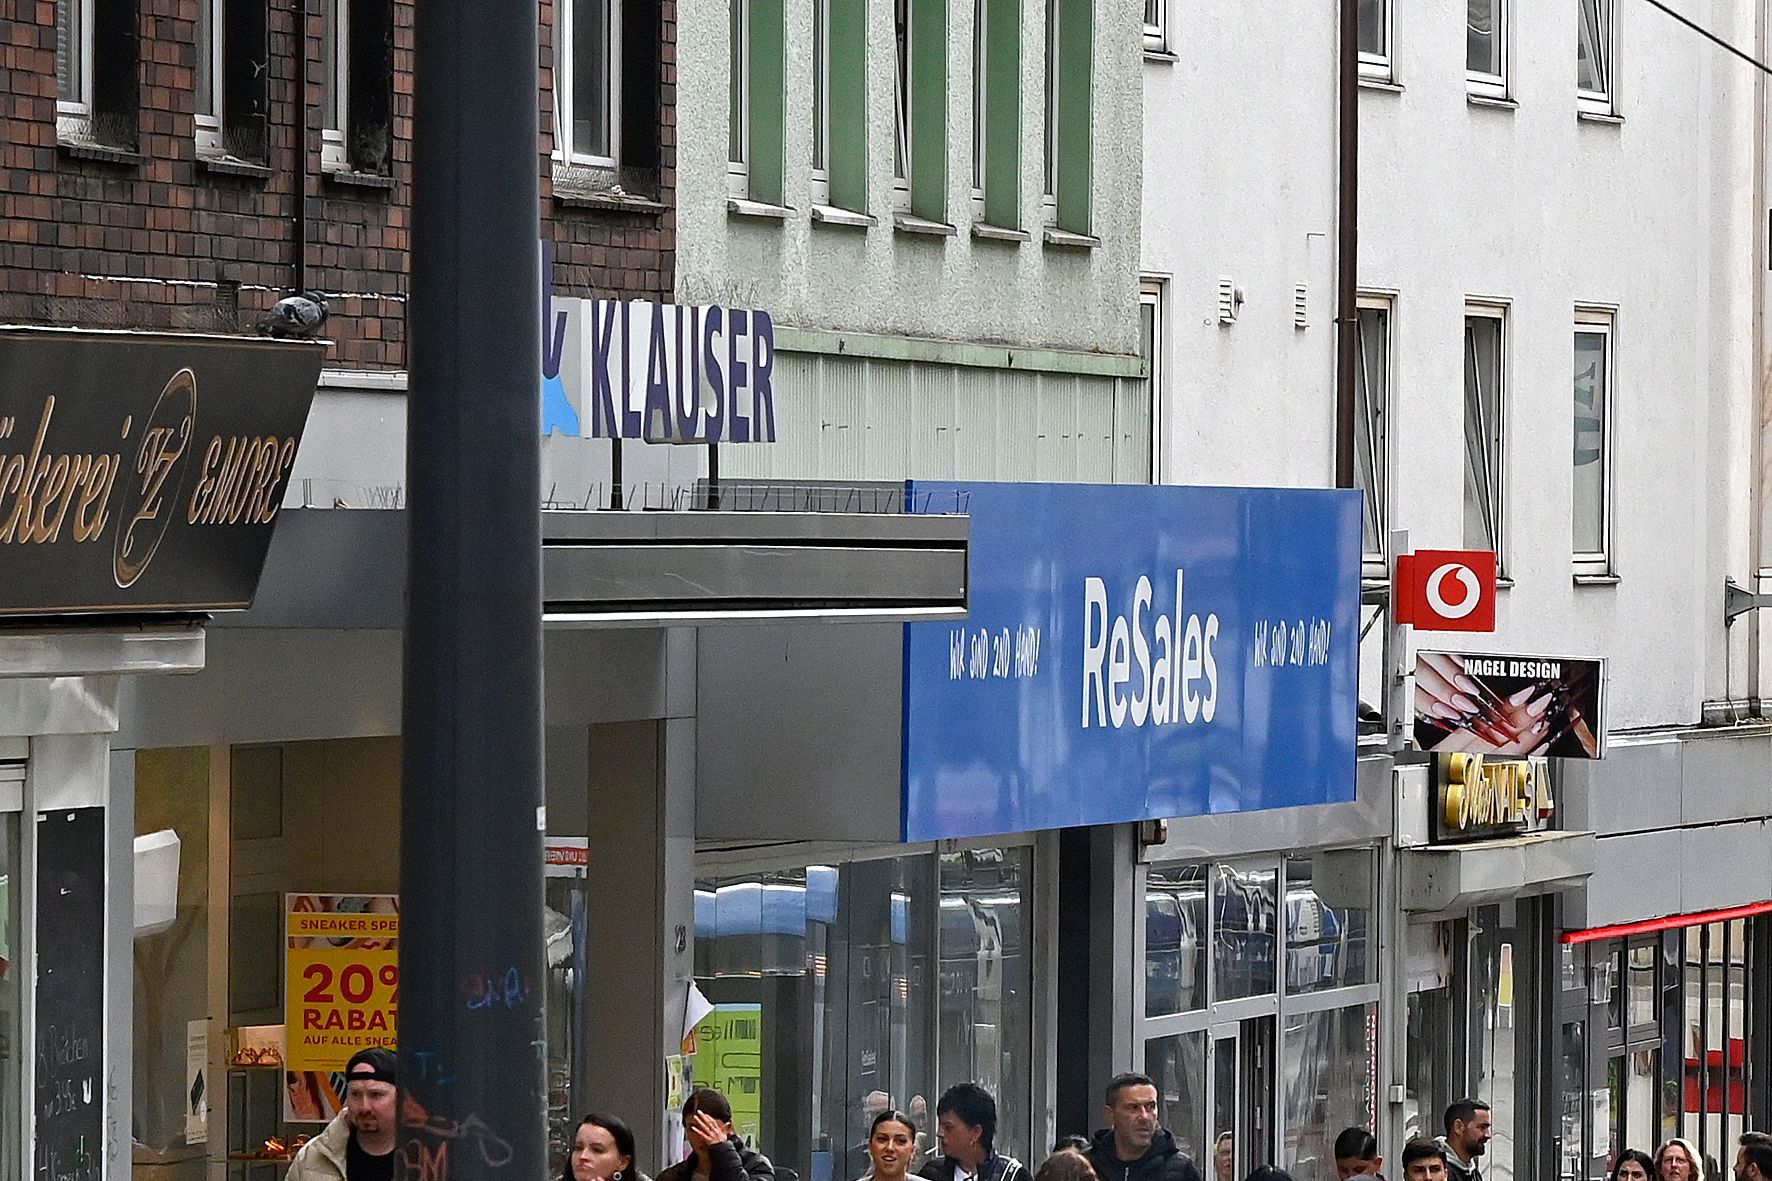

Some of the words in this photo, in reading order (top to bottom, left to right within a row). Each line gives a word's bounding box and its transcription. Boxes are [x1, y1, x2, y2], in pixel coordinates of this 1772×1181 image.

[592, 300, 776, 443] KLAUSER
[1081, 568, 1220, 728] ReSales
[1464, 659, 1507, 677] NAGEL
[1510, 661, 1561, 679] DESIGN
[300, 919, 368, 931] SNEAKER
[371, 920, 399, 931] SPE
[303, 1008, 399, 1031] RABAT
[303, 1036, 329, 1045] AUF
[331, 1036, 362, 1046] ALLE
[365, 1037, 397, 1046] SNEA
